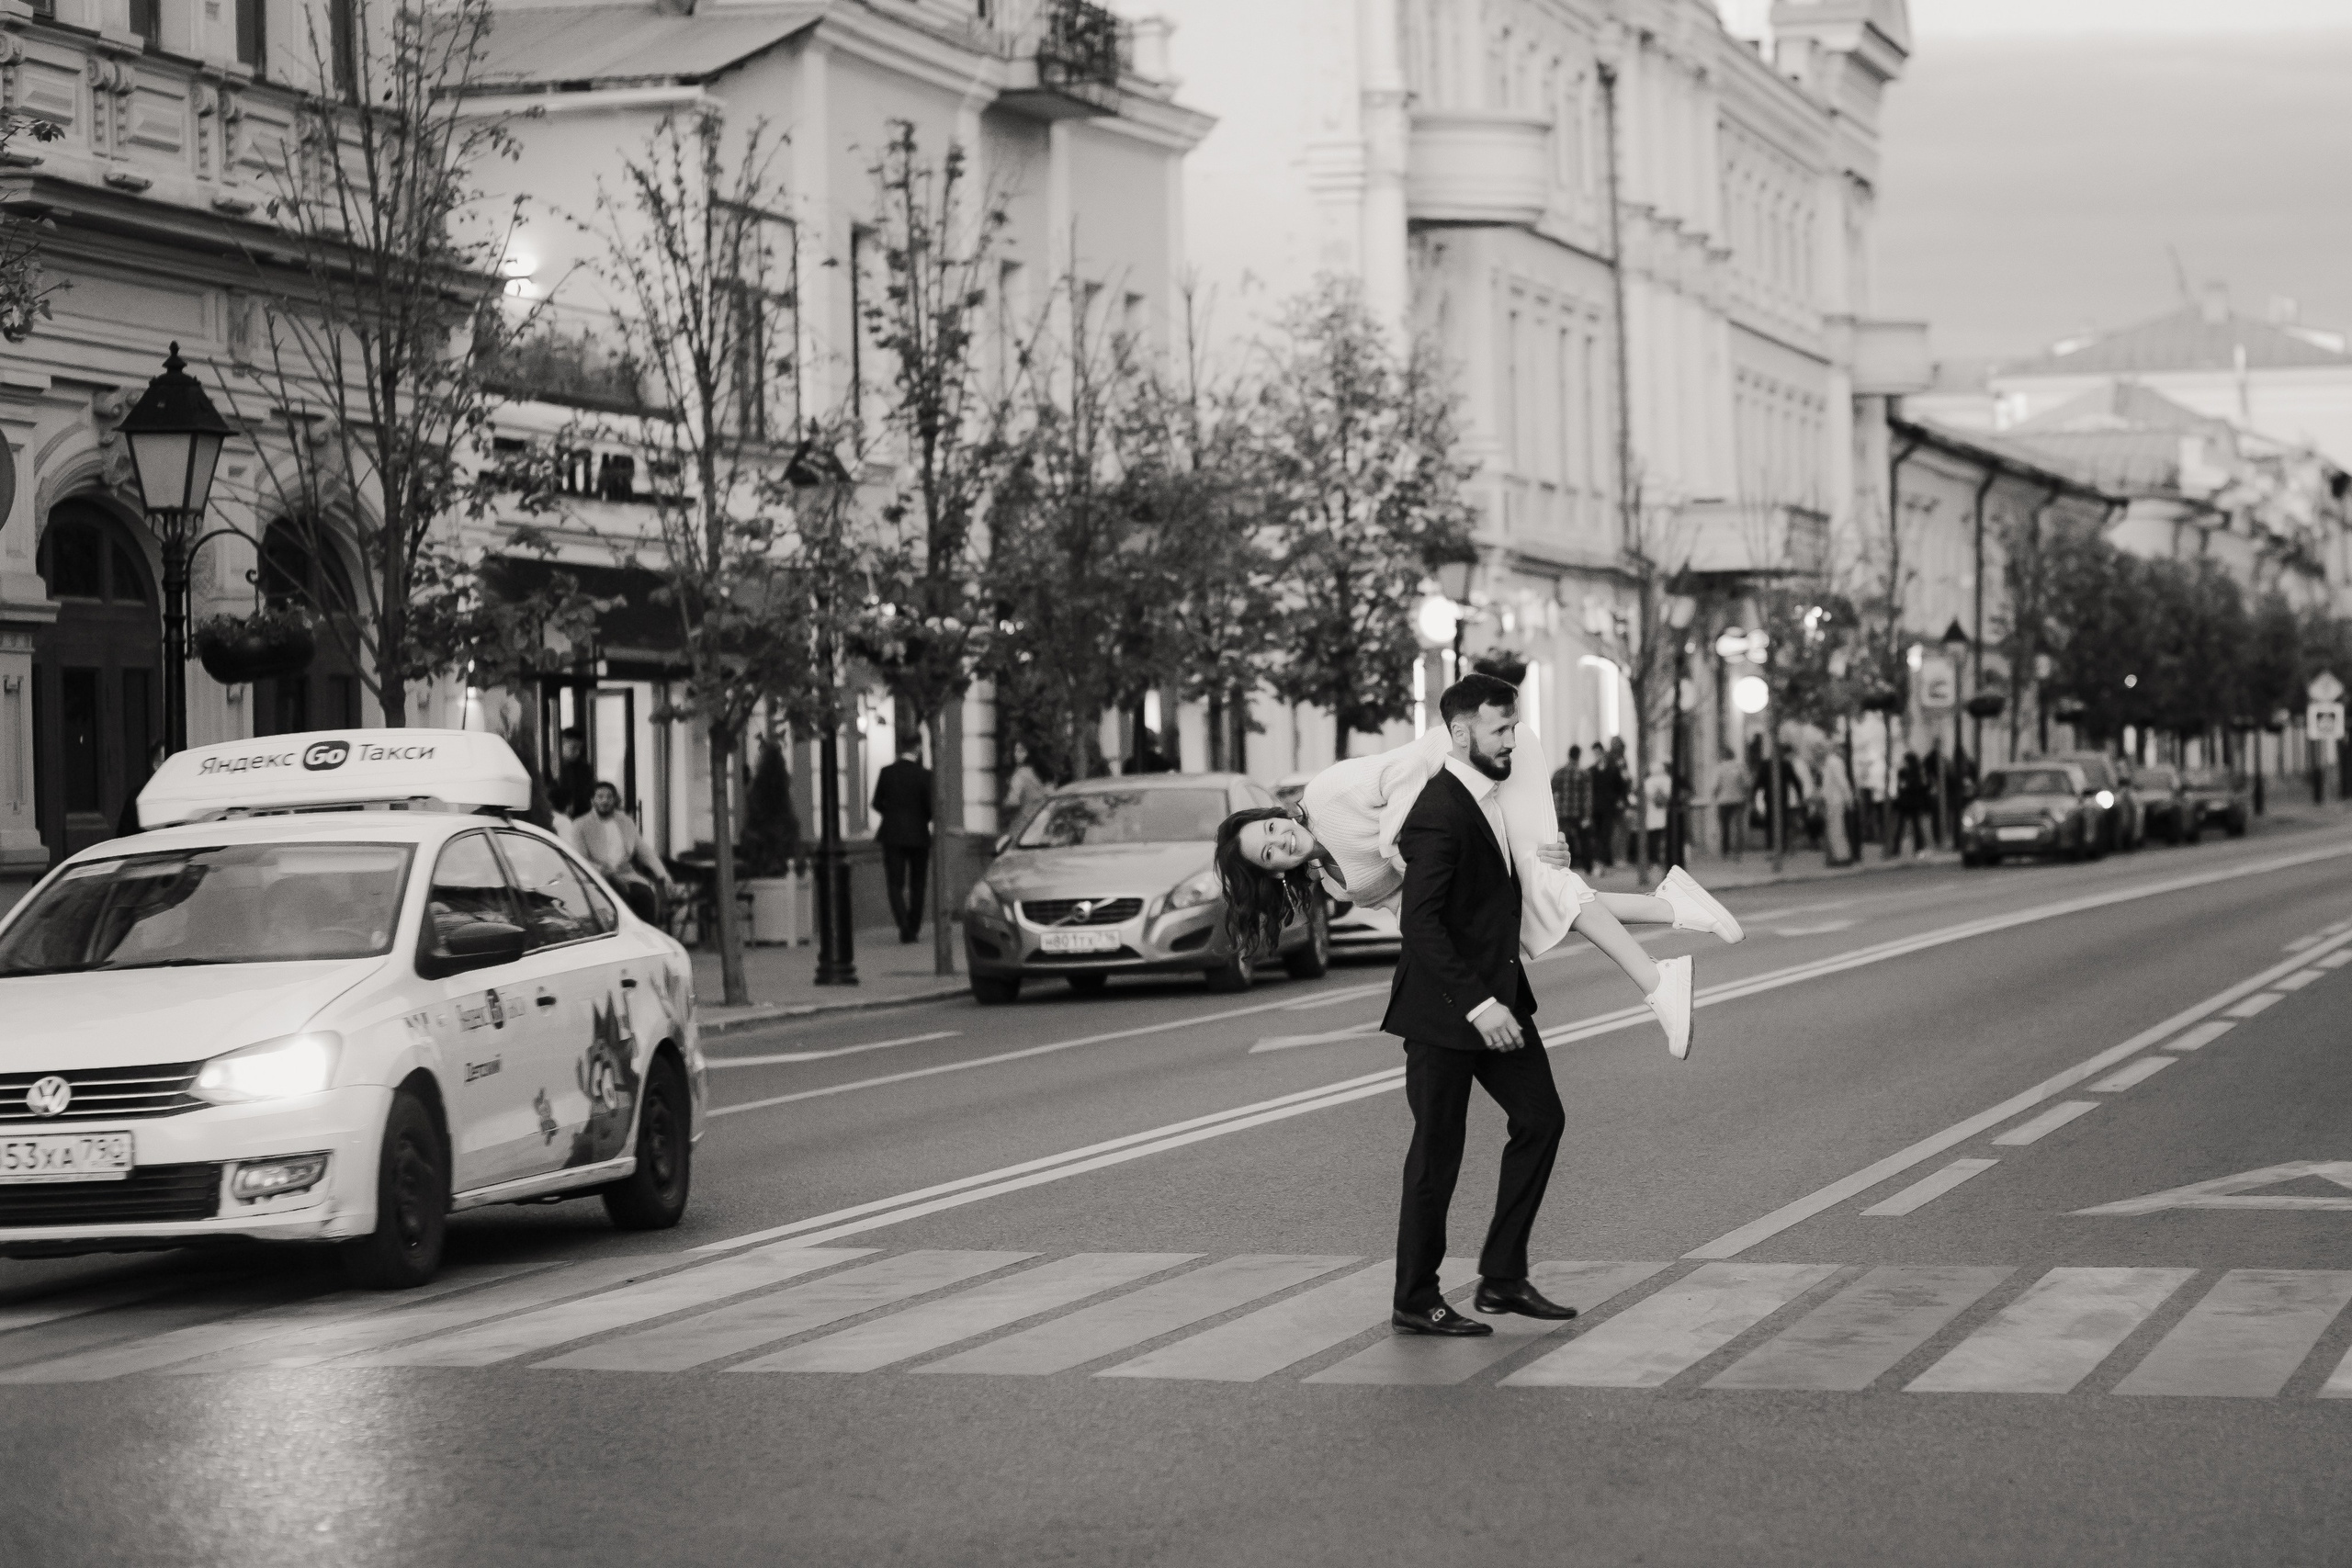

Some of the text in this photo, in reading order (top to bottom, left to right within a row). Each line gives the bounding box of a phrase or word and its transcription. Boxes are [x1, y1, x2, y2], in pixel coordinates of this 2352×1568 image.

[197, 743, 435, 775] Яндекс Go Такси
[0, 1142, 74, 1169] 53ХА
